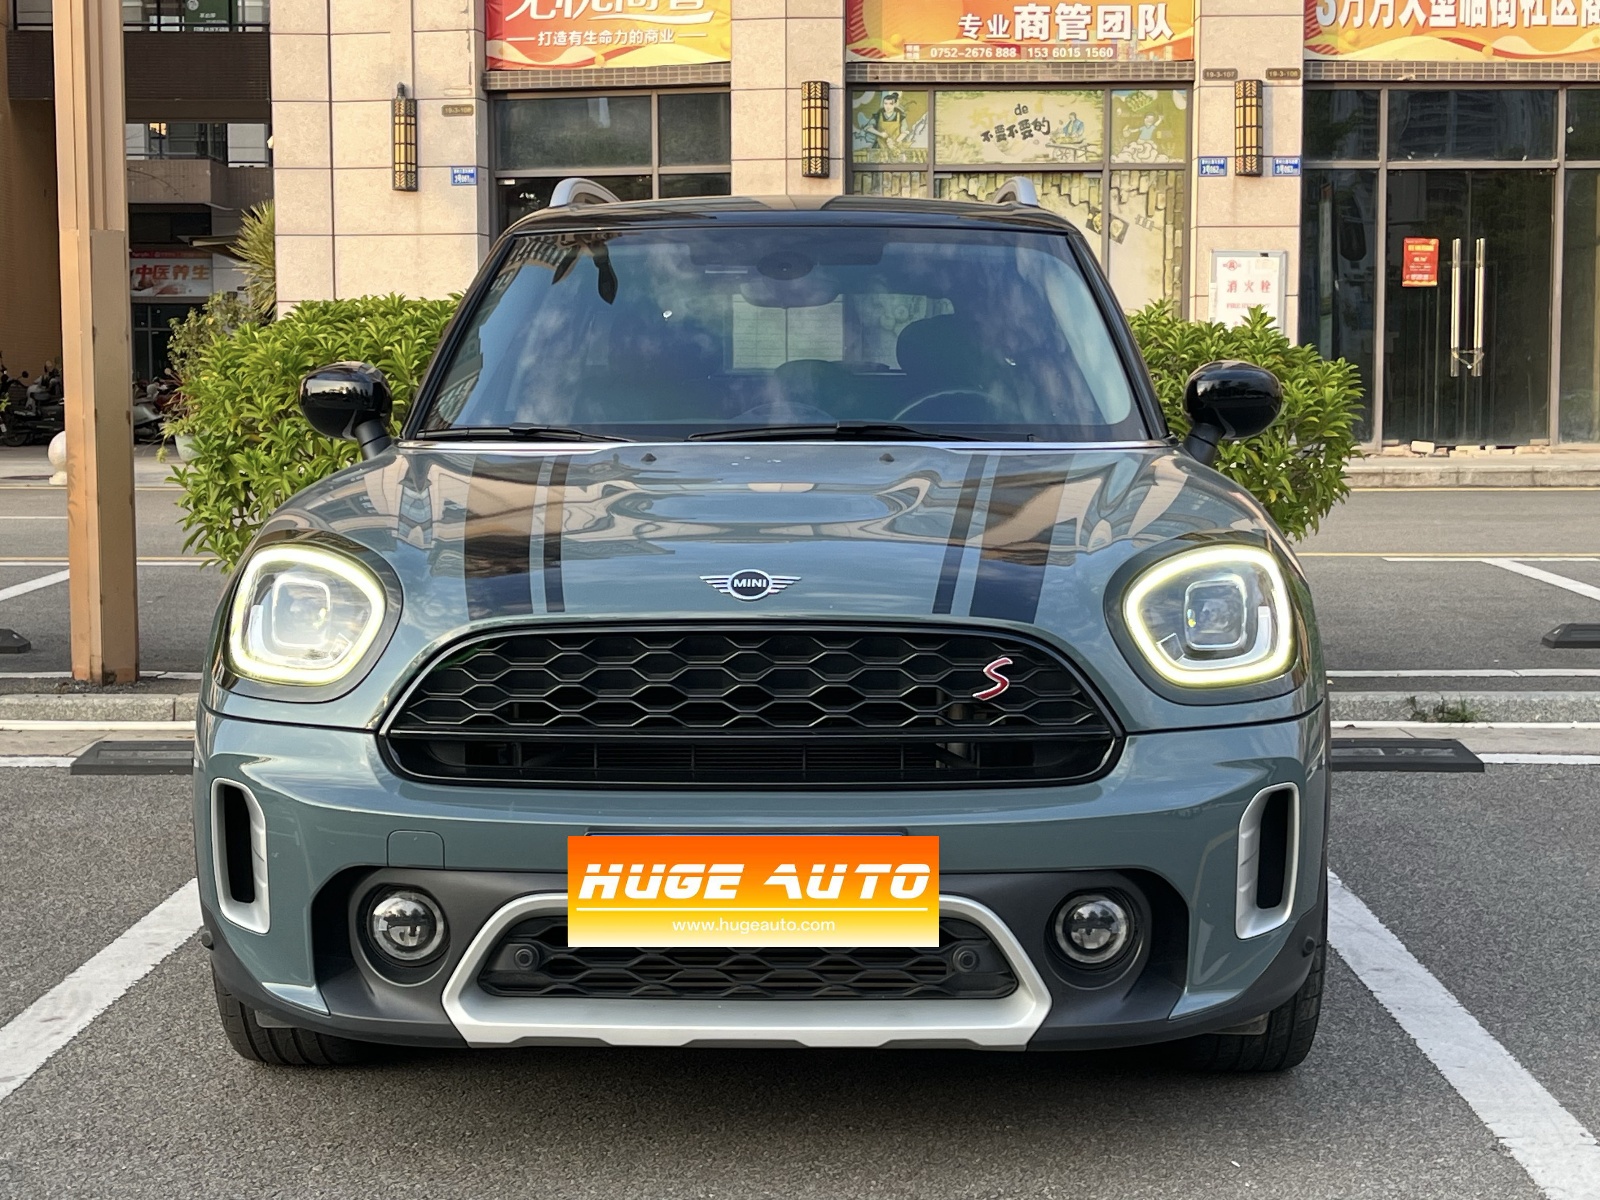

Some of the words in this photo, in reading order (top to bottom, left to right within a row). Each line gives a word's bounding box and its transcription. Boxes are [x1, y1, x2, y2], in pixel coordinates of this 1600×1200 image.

[957, 2, 1175, 41] 专业商管团队
[536, 28, 676, 47] 打造有生命力的商业
[929, 46, 993, 58] 0752-2676
[995, 46, 1017, 58] 888
[1027, 46, 1049, 58] 153
[1052, 46, 1081, 58] 6015
[1085, 46, 1114, 58] 1560
[1014, 102, 1029, 116] de
[980, 116, 1051, 143] 不要不要的
[135, 264, 210, 281] 中医养生
[1226, 280, 1272, 294] 消火栓
[733, 578, 768, 588] MINI
[972, 656, 1014, 702] S
